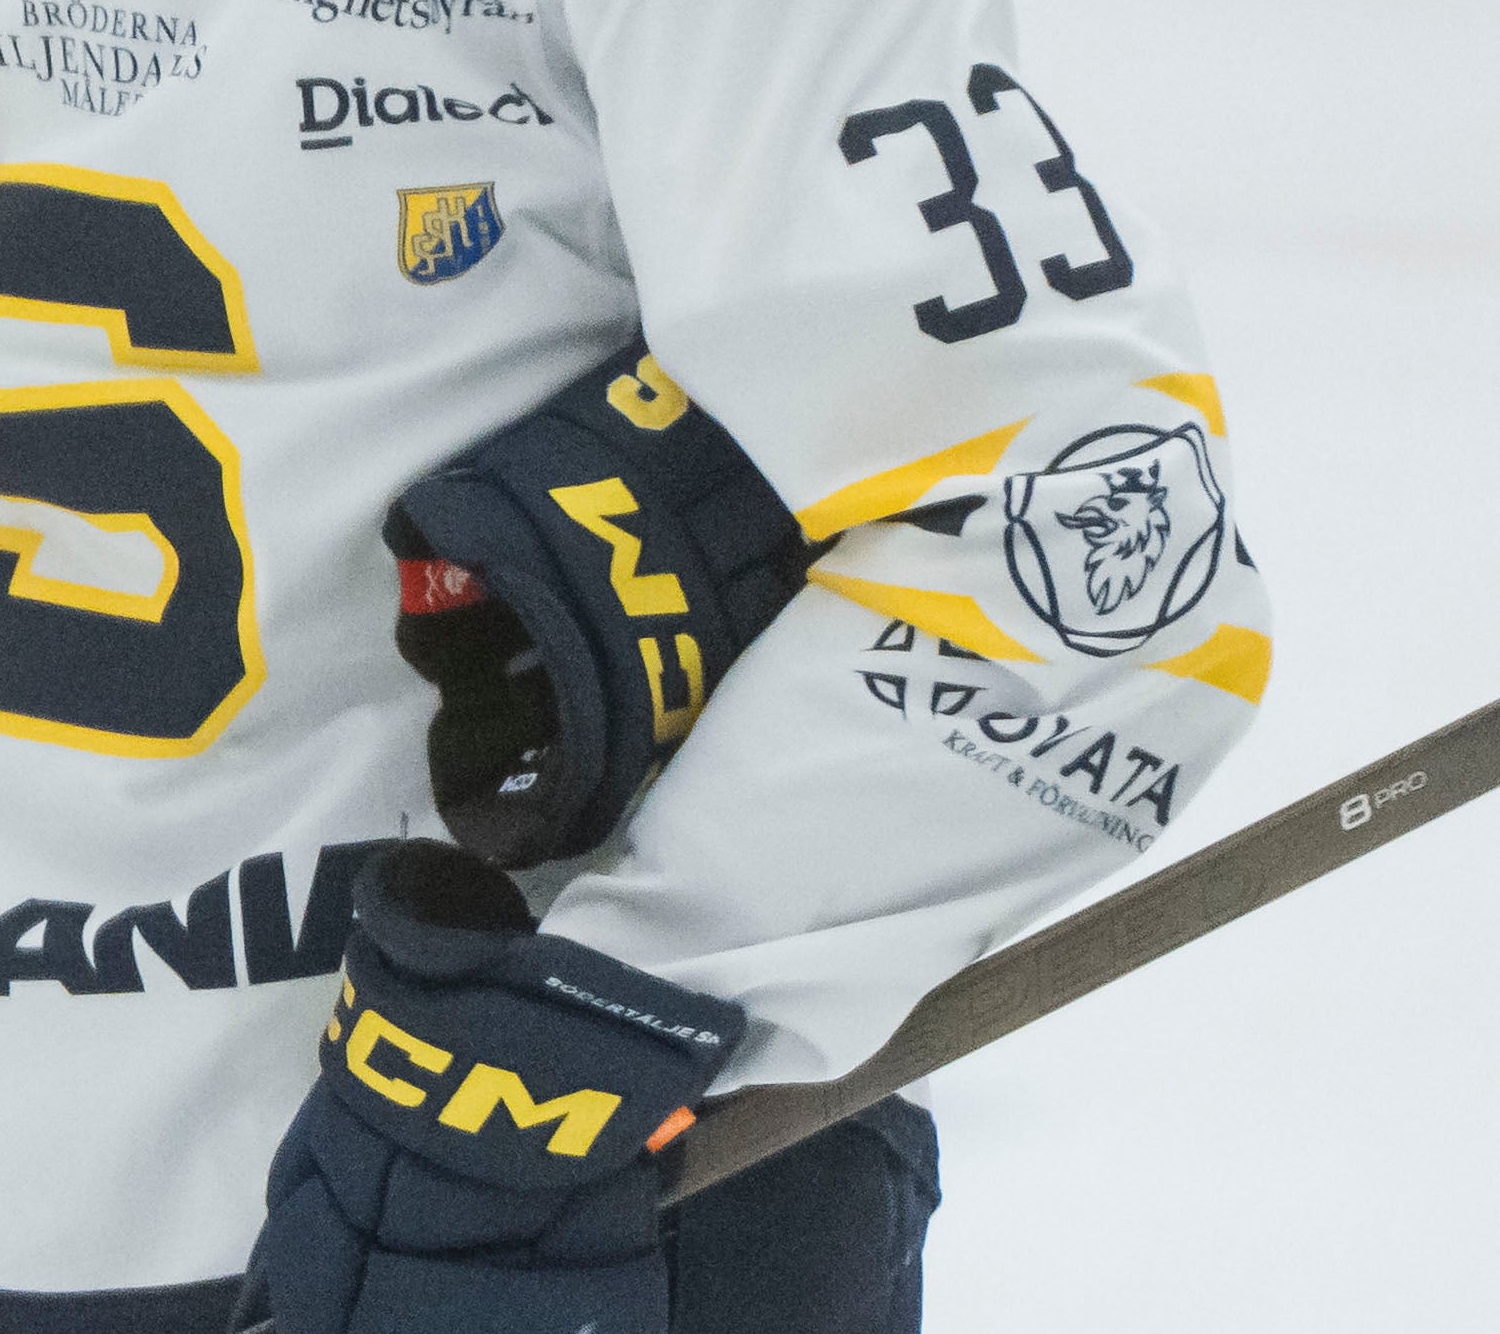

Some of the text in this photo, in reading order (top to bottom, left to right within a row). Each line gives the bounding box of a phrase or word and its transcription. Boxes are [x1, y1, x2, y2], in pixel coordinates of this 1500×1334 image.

[838, 63, 1135, 345] 33
[1339, 770, 1429, 832] 8 PRO
